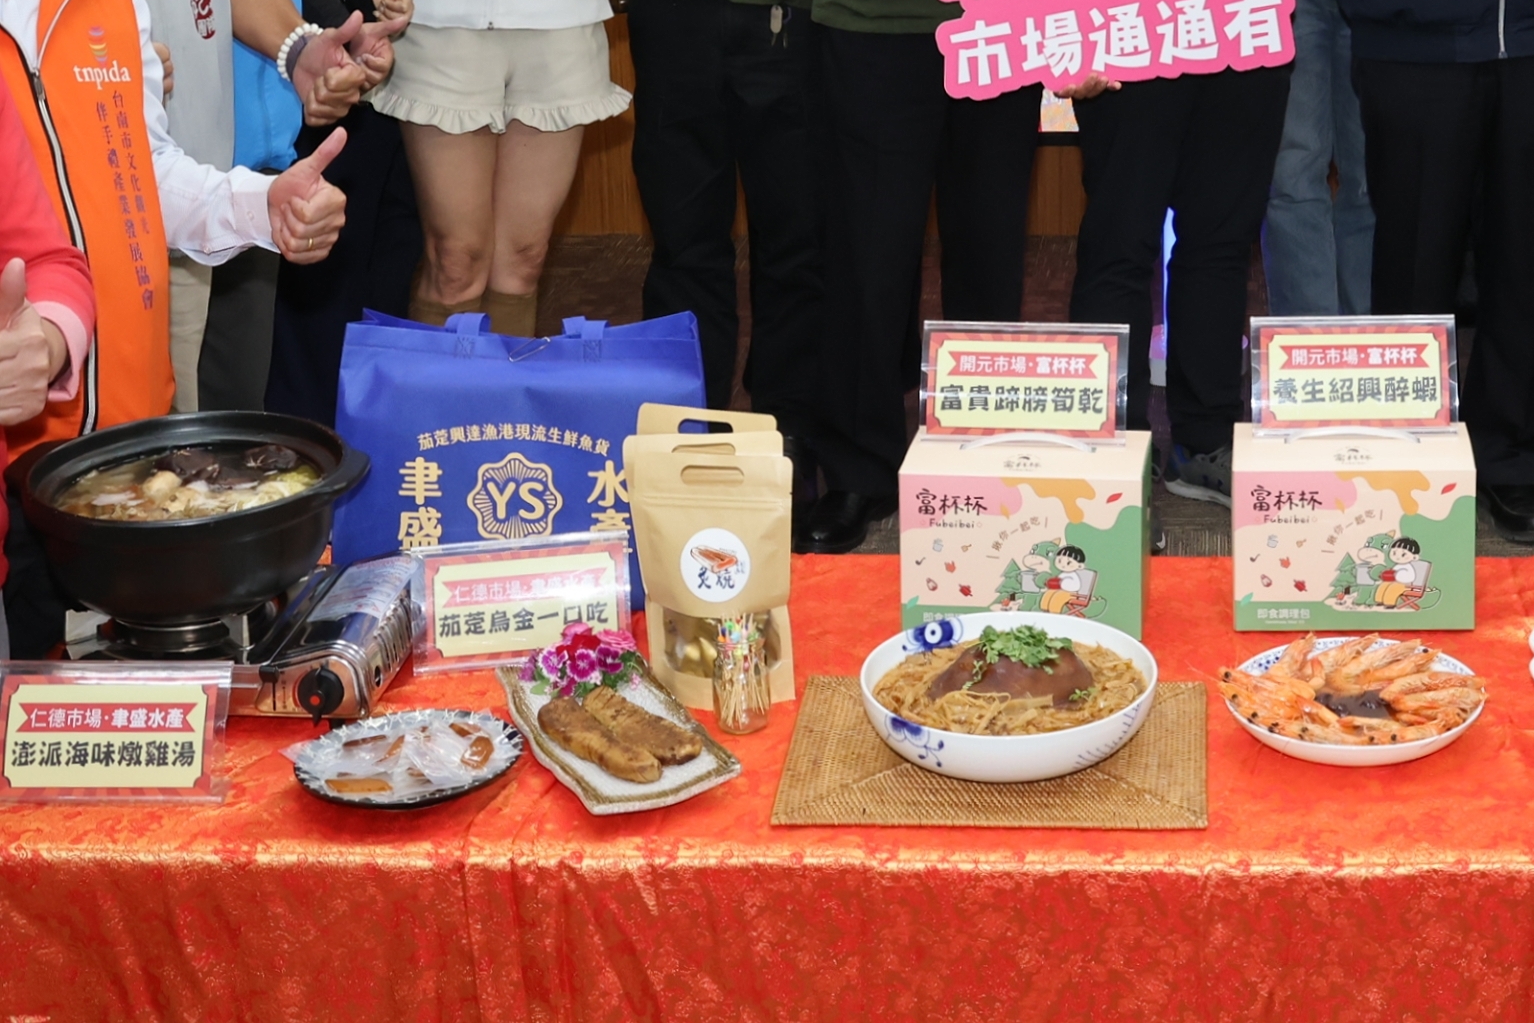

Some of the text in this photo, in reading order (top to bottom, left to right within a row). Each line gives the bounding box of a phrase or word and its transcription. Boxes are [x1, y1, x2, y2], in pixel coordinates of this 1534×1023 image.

[73, 60, 131, 90] tnpida
[96, 100, 155, 311] 伴手禮產業發展協會
[939, 383, 1105, 415] 富貴蹄膀筍乾
[1273, 375, 1439, 405] 養生紹興醉蝦
[416, 422, 611, 458] 茄萣興達漁港現流生鮮魚貨
[486, 480, 546, 520] YS
[915, 487, 989, 517] 富杯杯
[1250, 484, 1323, 513] 富杯杯
[929, 517, 976, 529] Fubeibei
[1263, 514, 1311, 525] Fubeibei
[10, 740, 197, 768] 澎派海味燉雞湯
